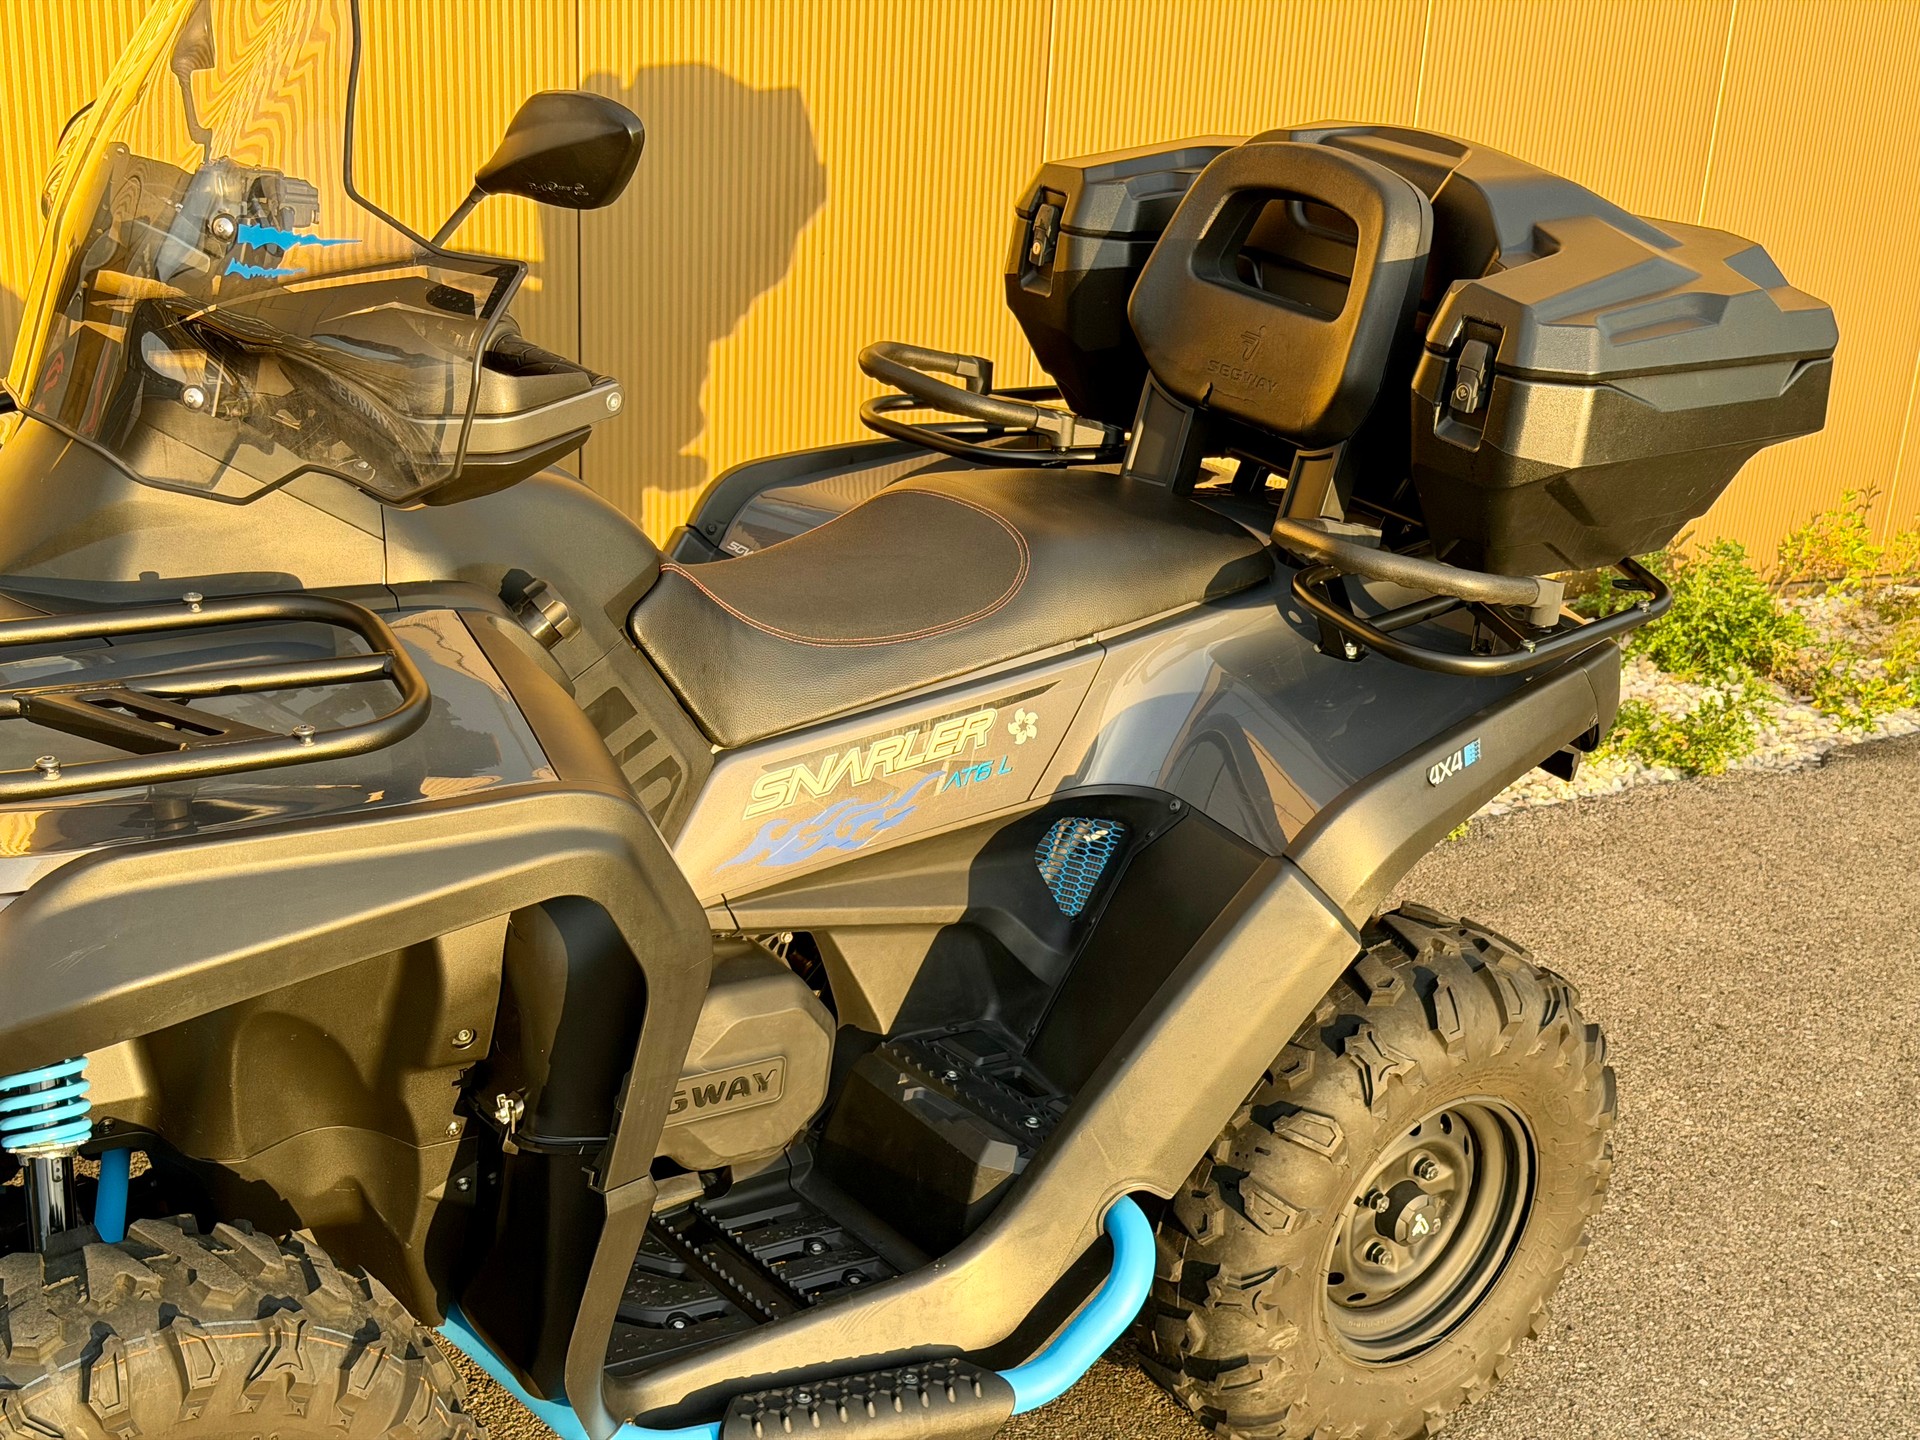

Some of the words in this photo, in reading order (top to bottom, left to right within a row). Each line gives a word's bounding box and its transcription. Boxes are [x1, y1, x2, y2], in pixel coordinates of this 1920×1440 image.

[1207, 359, 1278, 393] SEGWAY
[743, 708, 998, 820] SNARLER
[941, 760, 995, 793] AT6
[997, 754, 1013, 775] L
